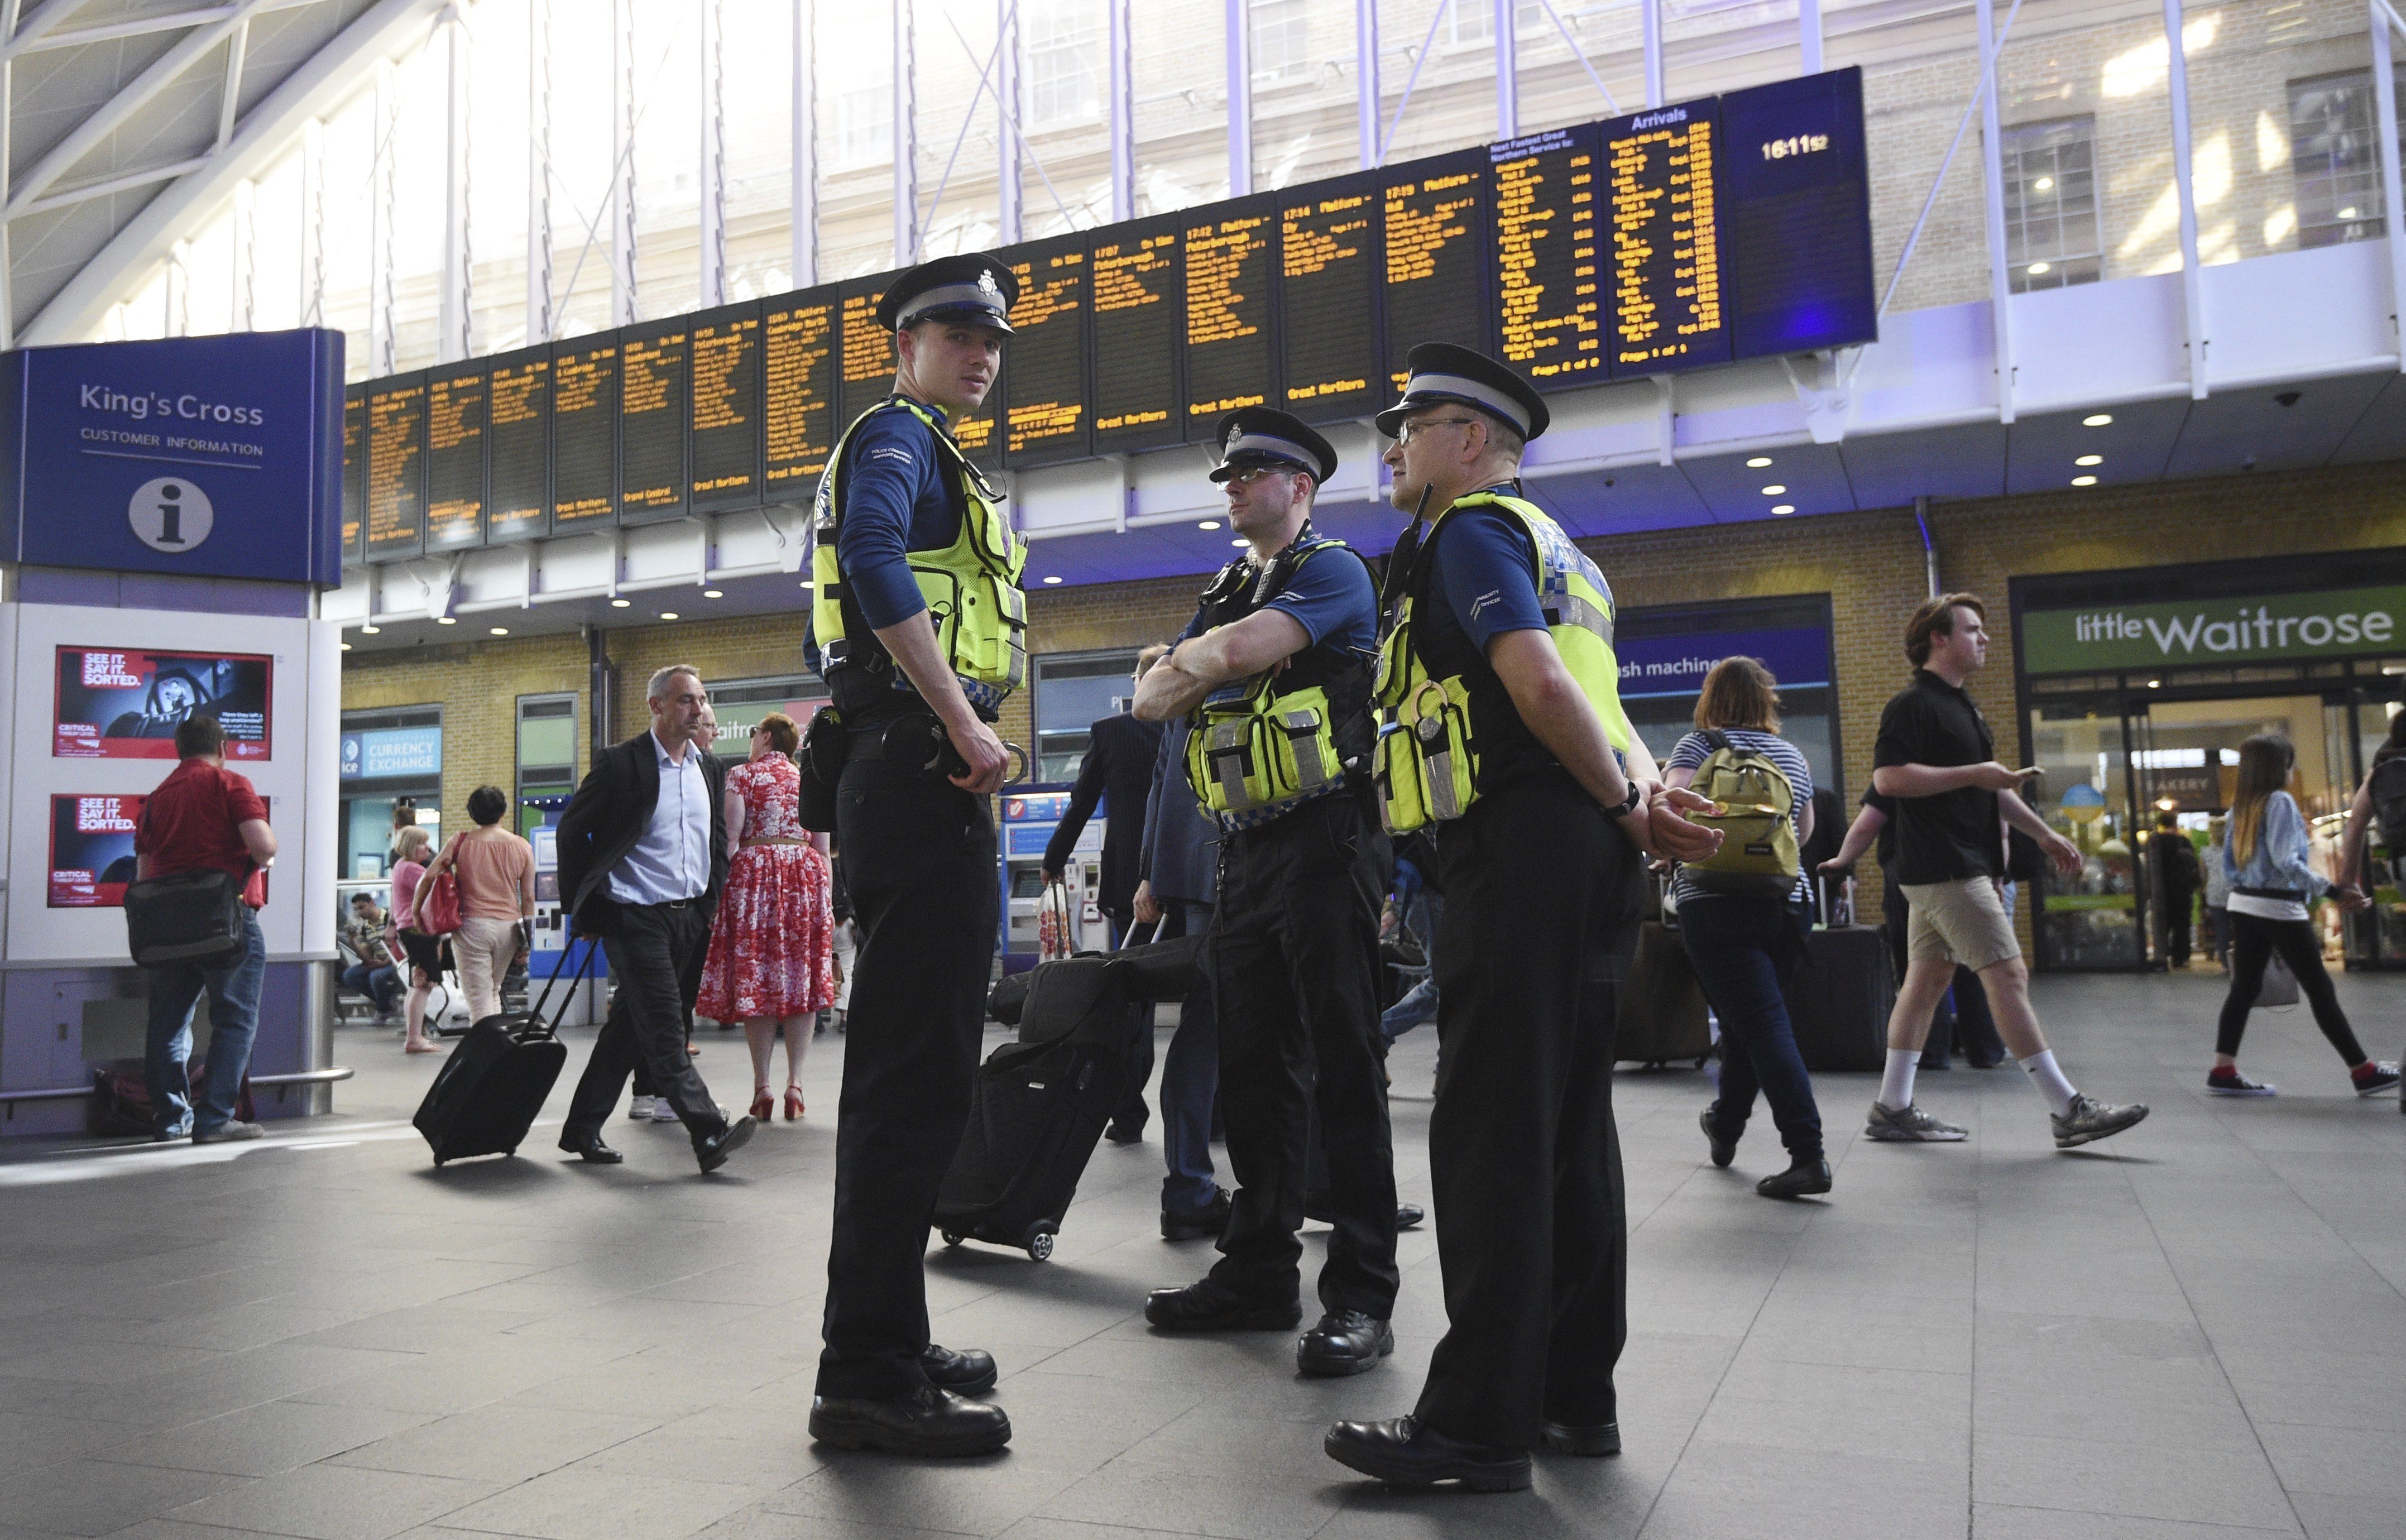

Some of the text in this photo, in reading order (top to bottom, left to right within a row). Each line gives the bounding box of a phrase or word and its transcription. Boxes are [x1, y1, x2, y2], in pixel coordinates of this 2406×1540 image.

[1632, 109, 1688, 131] Arrivals
[1510, 136, 1542, 148] Fastest
[1542, 129, 1567, 142] Great
[1491, 148, 1528, 162] Northern
[1528, 142, 1561, 155] Service
[1424, 174, 1469, 191] Platform
[1320, 196, 1362, 213] Platform
[1221, 217, 1261, 233] Platform
[1140, 239, 1153, 250] On
[1155, 234, 1175, 247] time
[1186, 231, 1249, 252] Peterborough
[1051, 257, 1063, 267] On
[1065, 253, 1084, 265] time
[1094, 251, 1155, 271] Peterborough
[794, 306, 826, 320] Platform
[804, 316, 827, 328] North
[694, 334, 742, 351] Peterborough
[1288, 380, 1365, 400] Great Northern
[80, 384, 263, 425] King's Cross
[1190, 395, 1263, 415] Great Northern
[1097, 411, 1167, 430] Great Northern
[80, 428, 263, 455] CUSTOMER INFORMATION
[766, 464, 825, 480] Great Northern
[694, 476, 749, 491] Great Northern
[624, 490, 644, 502] Grand
[646, 486, 670, 498] Central
[2076, 606, 2394, 655] little Waitrose
[85, 653, 126, 664] SEE IT.
[85, 664, 126, 675] SAY IT.
[85, 674, 141, 686] SORTED.
[370, 741, 434, 757] CURRENCY
[341, 761, 358, 773] ice
[370, 756, 434, 771] EXCHANGE
[80, 798, 121, 808] SEE IT.
[80, 808, 121, 819] SAY IT.
[79, 819, 136, 830] SORTED.
